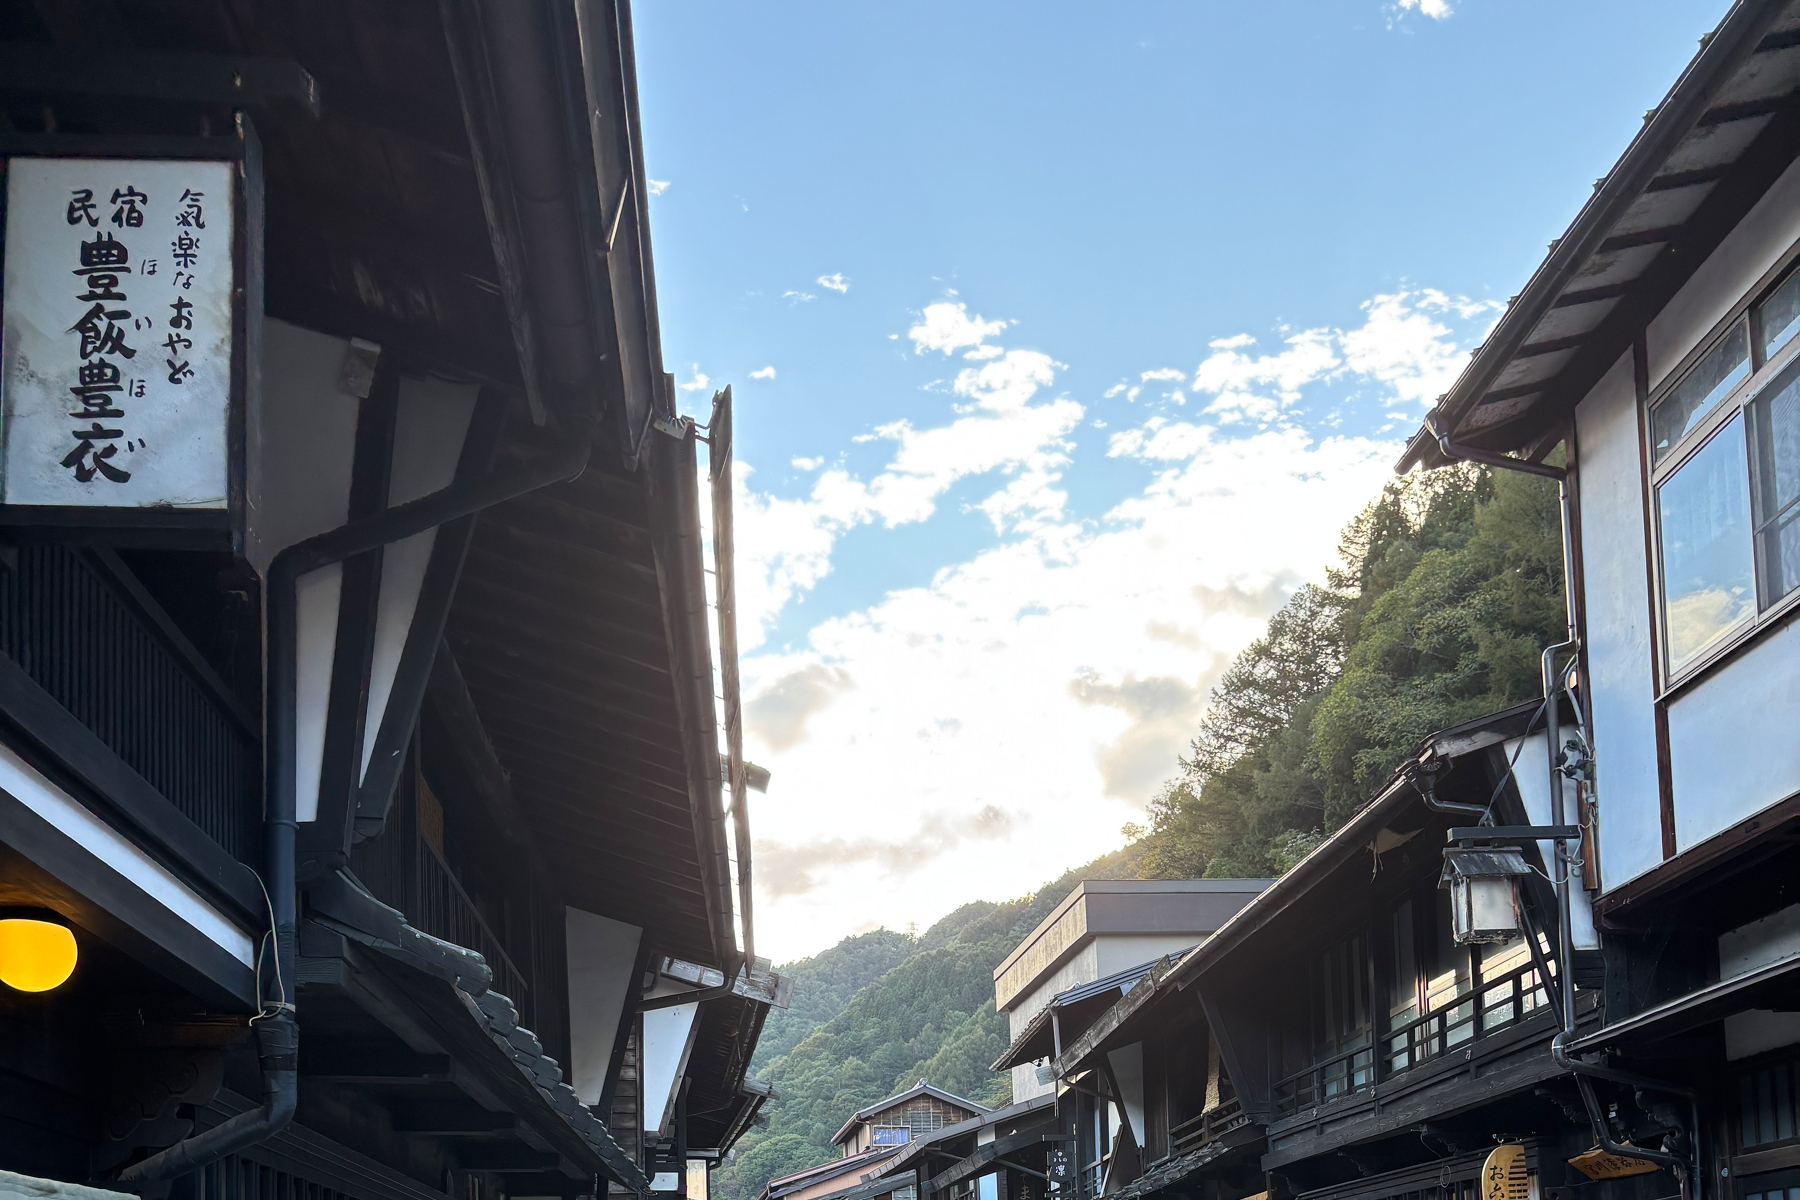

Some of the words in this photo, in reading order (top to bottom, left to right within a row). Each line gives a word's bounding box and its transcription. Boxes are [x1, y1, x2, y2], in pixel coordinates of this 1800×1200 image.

[66, 185, 148, 229] 民宿
[59, 231, 138, 484] 豊飯豊衣
